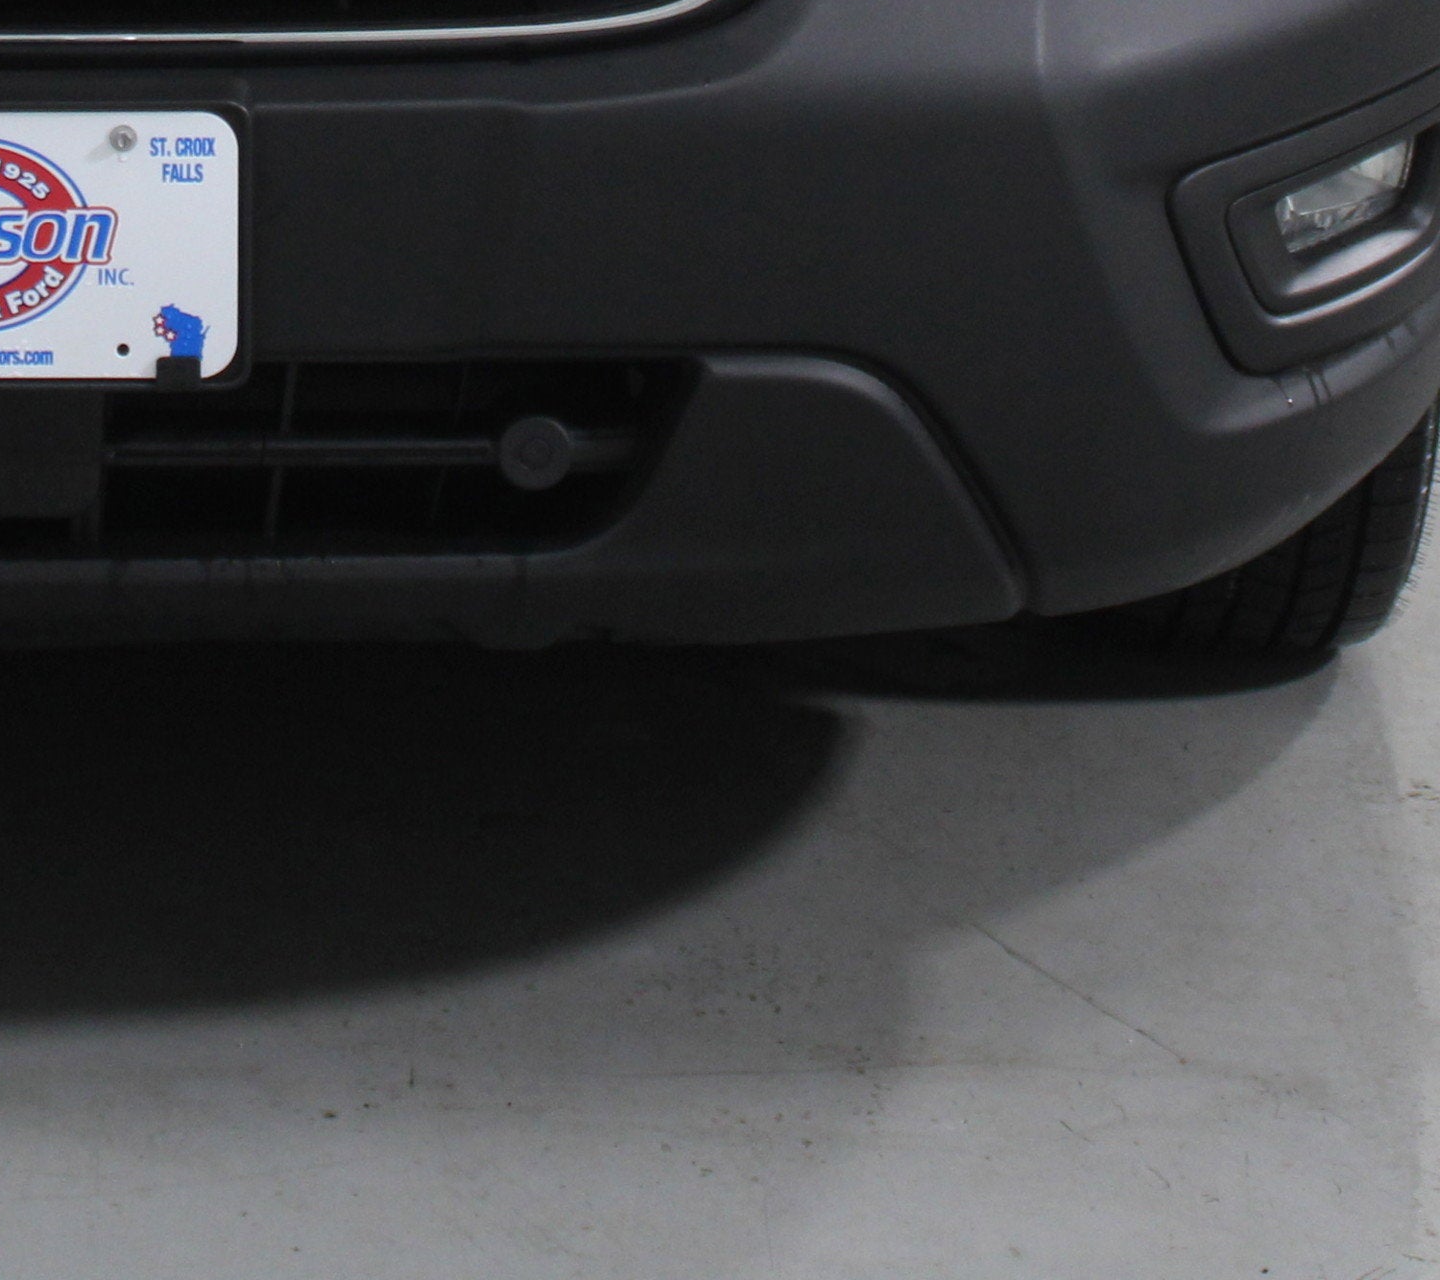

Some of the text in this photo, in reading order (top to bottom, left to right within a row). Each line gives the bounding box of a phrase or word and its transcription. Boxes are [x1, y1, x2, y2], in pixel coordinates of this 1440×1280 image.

[149, 137, 216, 157] ST. CROIX
[162, 163, 204, 183] FALLS
[97, 268, 135, 287] INC.
[4, 265, 67, 315] Ford
